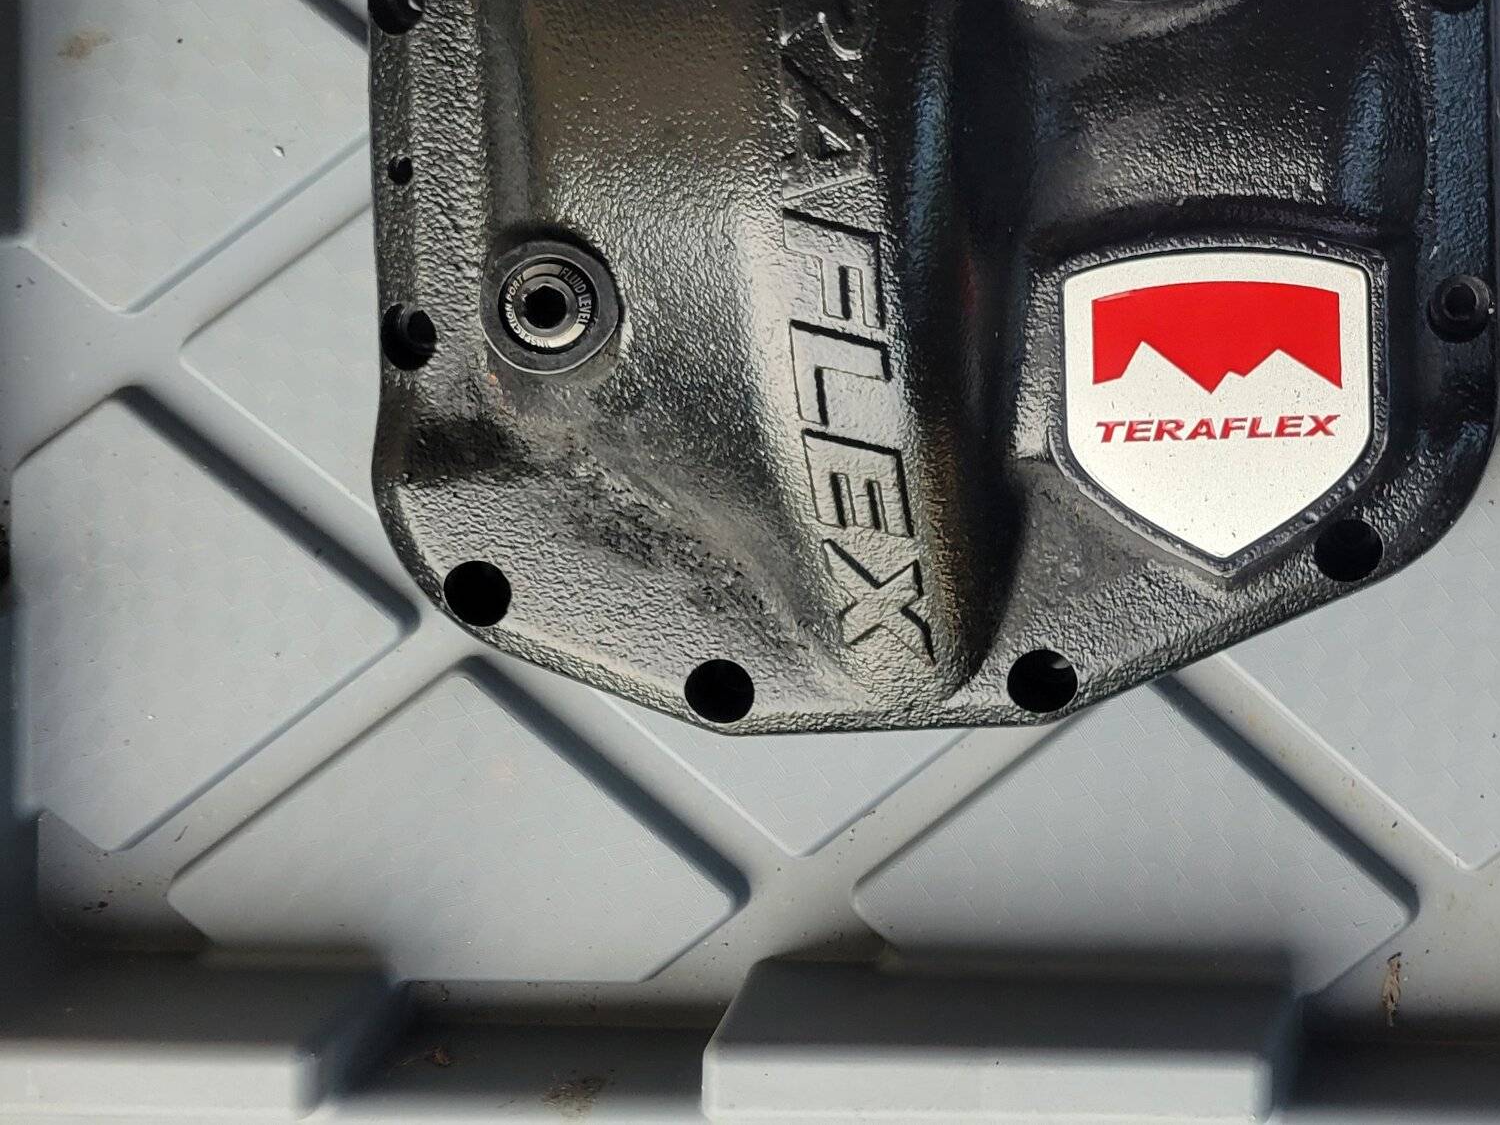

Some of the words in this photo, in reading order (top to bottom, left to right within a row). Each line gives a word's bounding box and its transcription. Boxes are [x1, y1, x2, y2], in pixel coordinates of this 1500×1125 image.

[505, 274, 524, 302] PORT
[560, 267, 587, 294] FLUID
[1095, 413, 1341, 443] TERAFLEX
